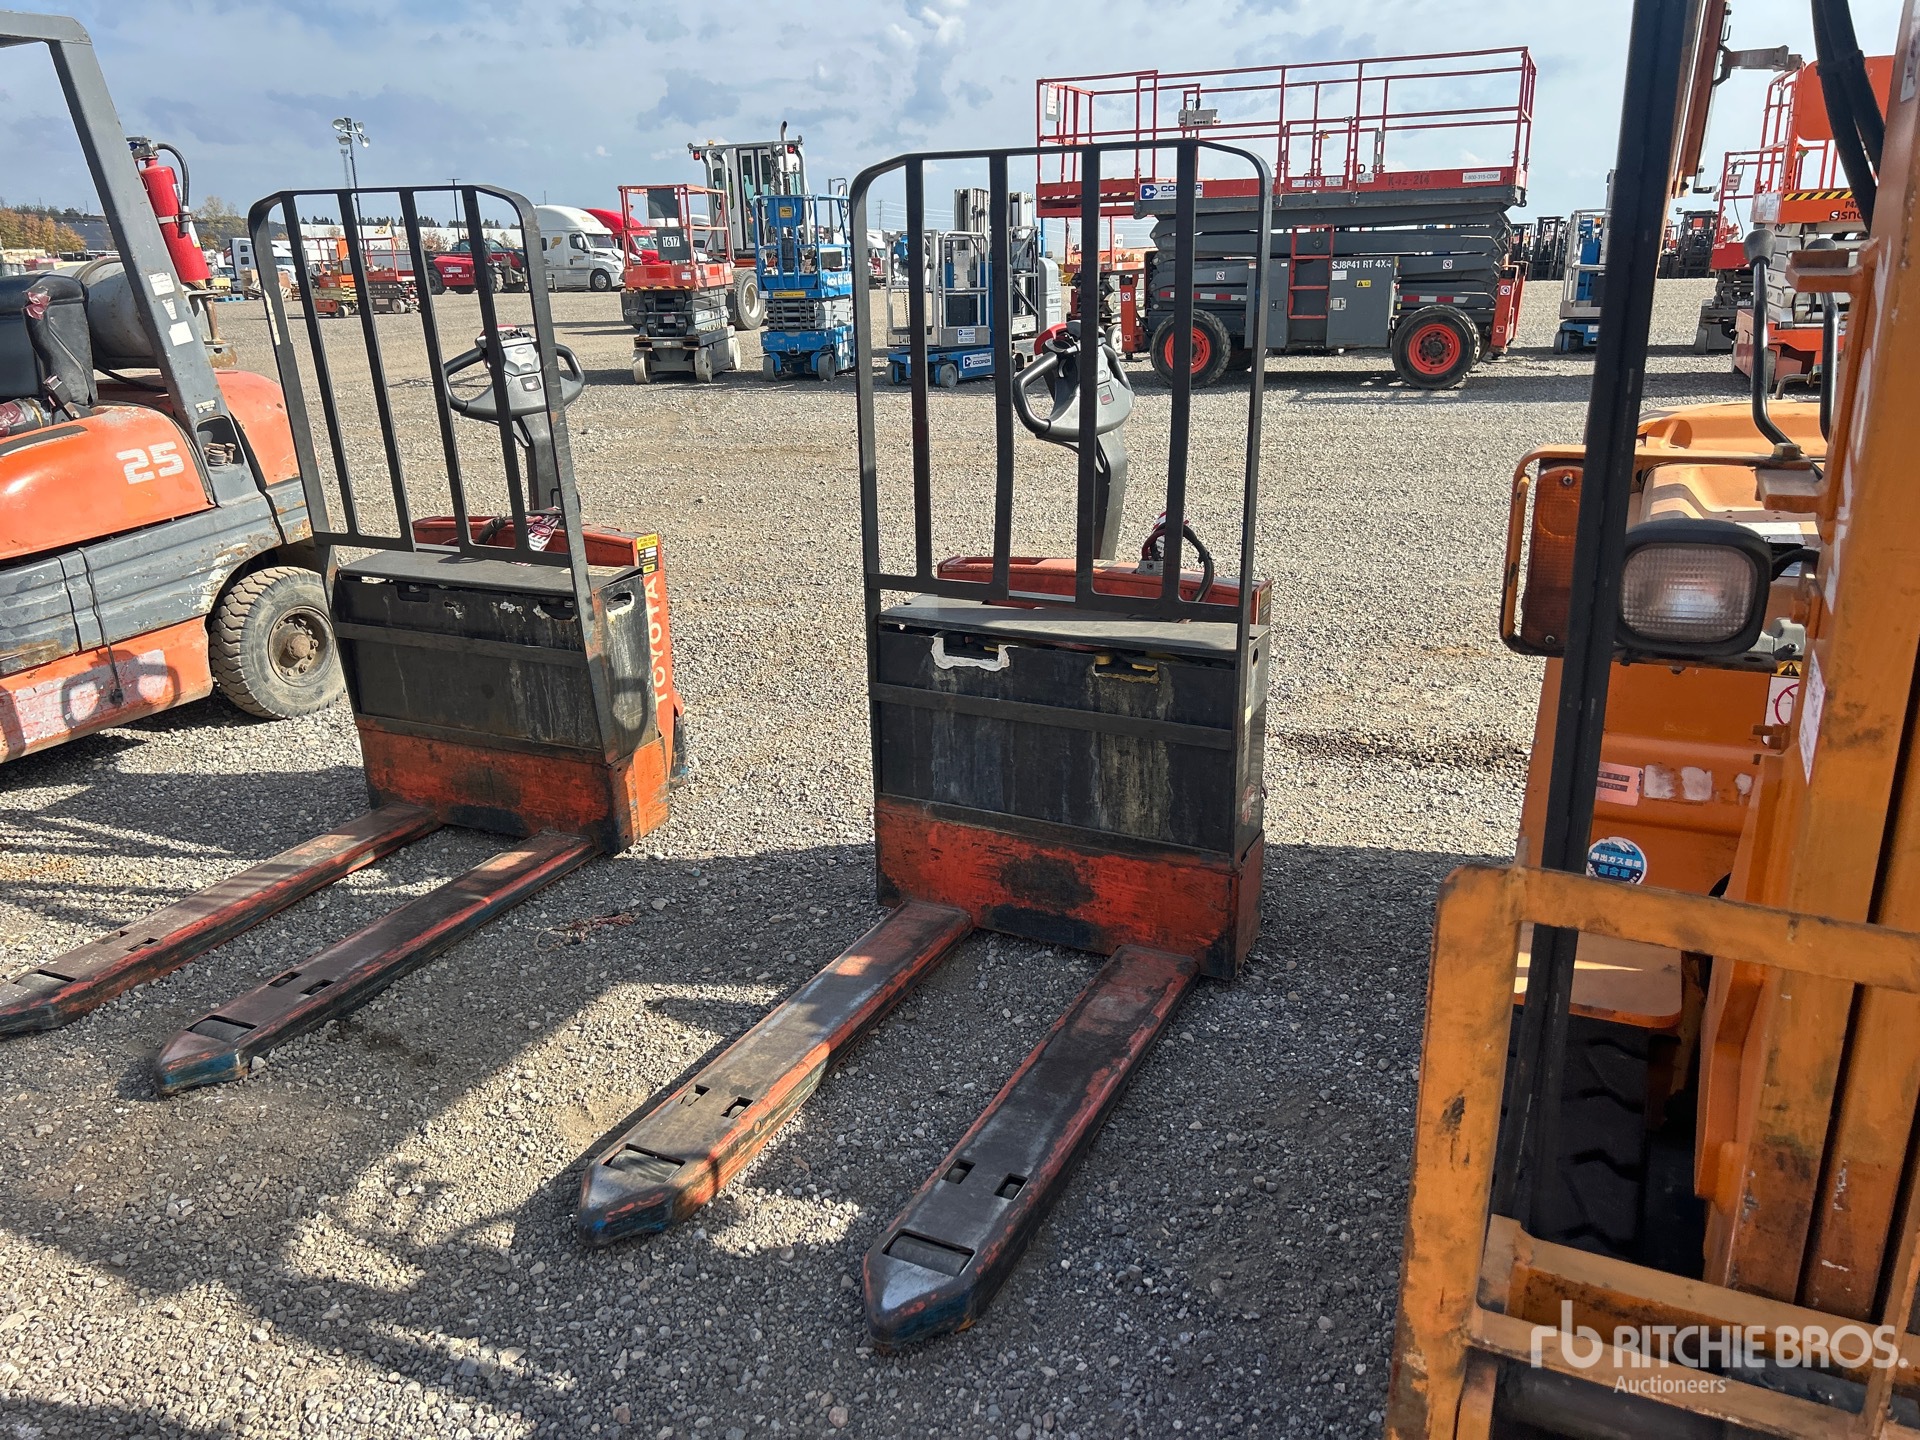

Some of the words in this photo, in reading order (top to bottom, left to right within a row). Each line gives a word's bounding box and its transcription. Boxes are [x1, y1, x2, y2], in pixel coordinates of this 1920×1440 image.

[663, 236, 680, 248] 1617
[1362, 260, 1374, 269] RT
[116, 441, 185, 485] 25
[645, 577, 668, 709] TOYOTA
